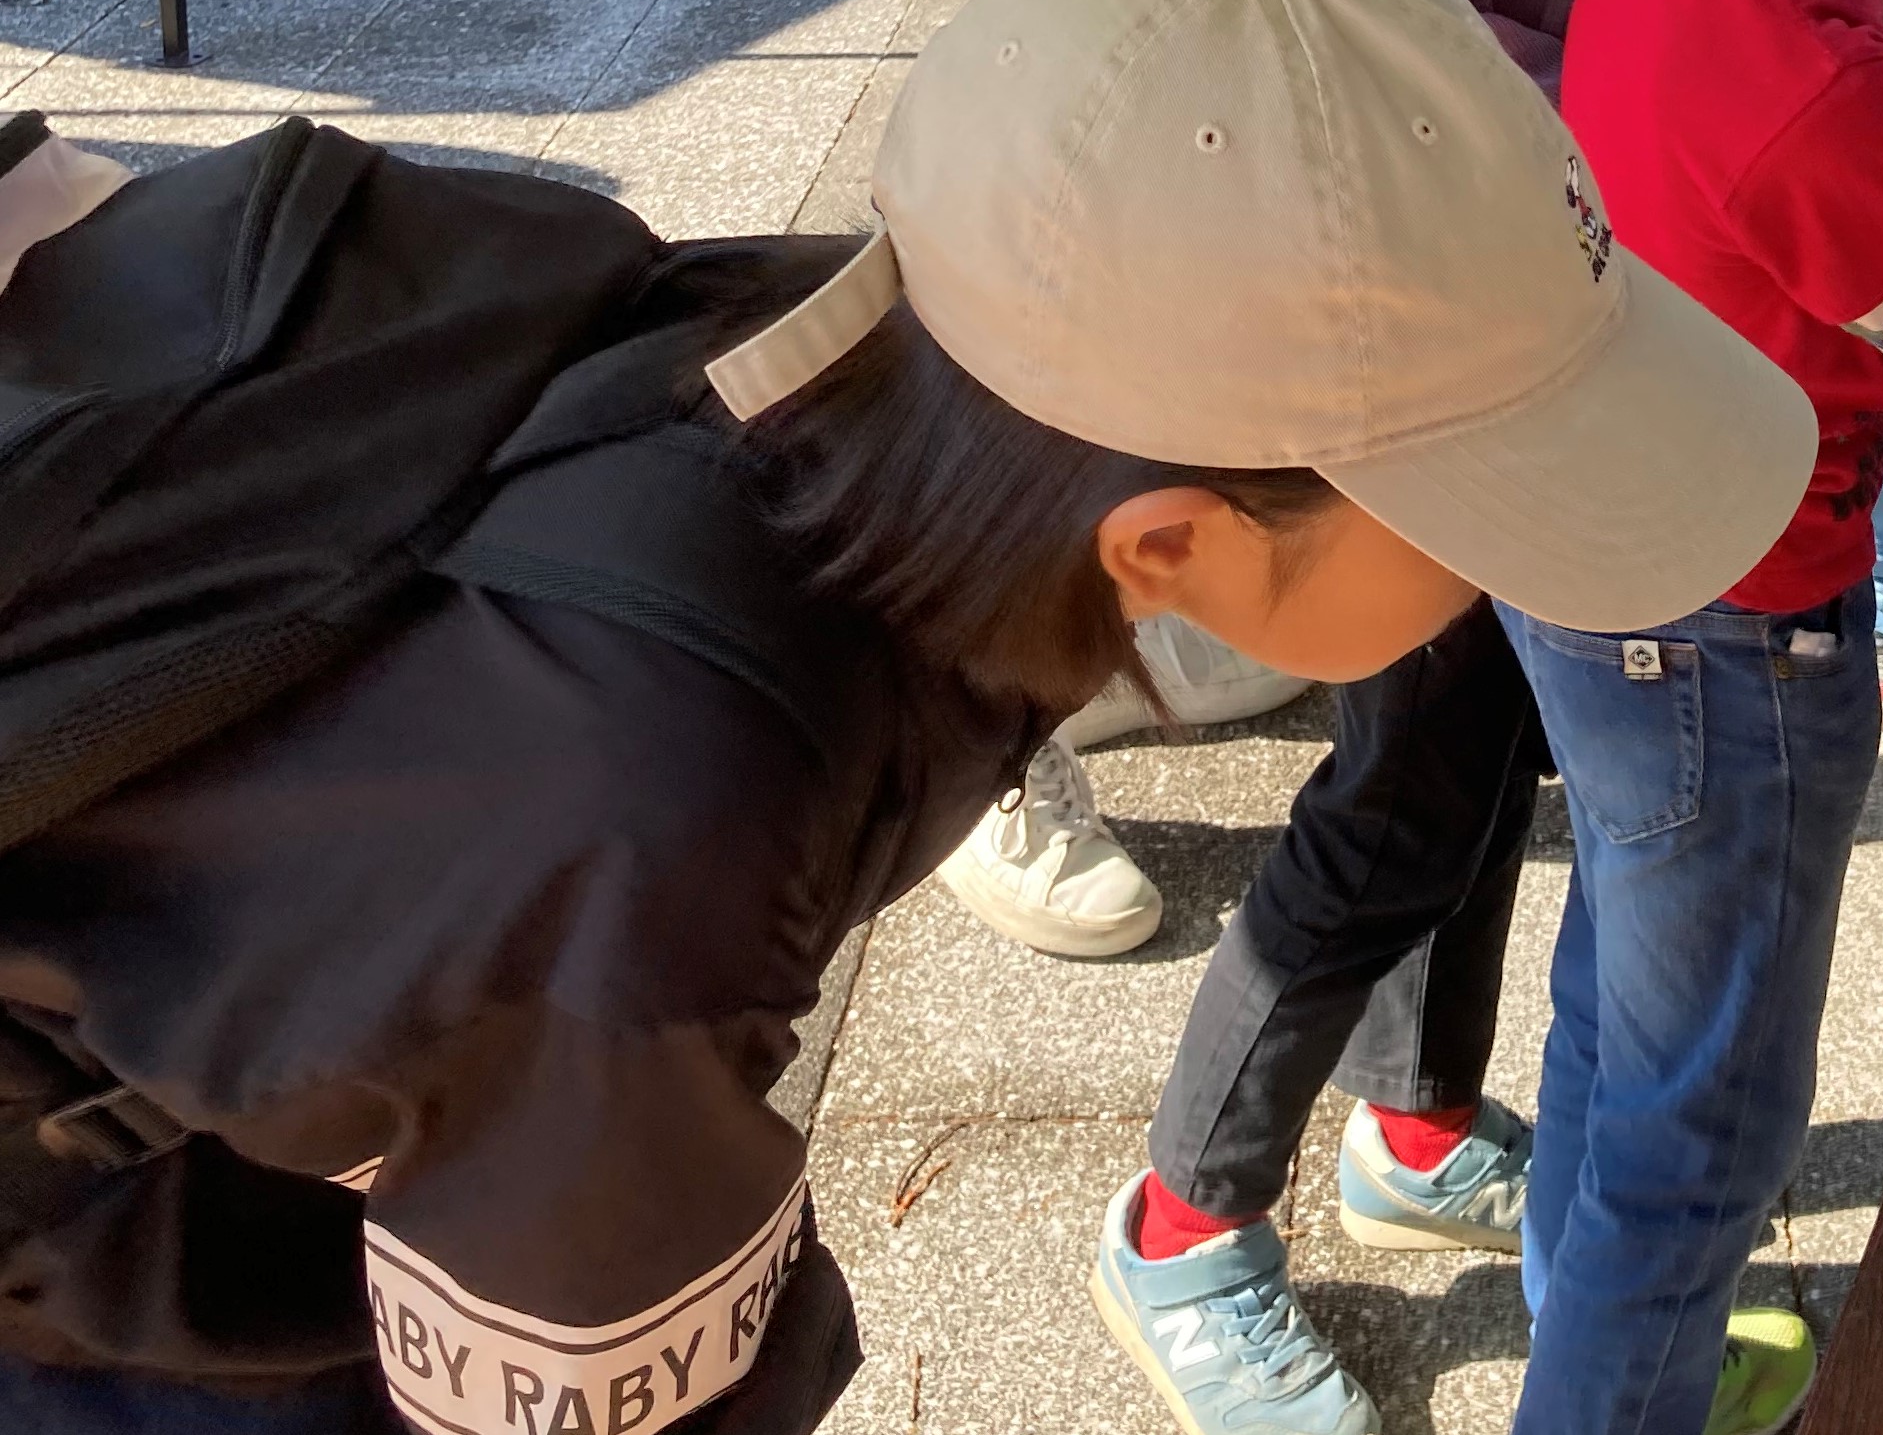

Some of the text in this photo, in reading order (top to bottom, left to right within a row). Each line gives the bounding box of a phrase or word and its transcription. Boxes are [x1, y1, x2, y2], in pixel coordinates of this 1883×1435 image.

[370, 1216, 803, 1435] ABY RABY RAB
[1153, 1307, 1221, 1372] N
